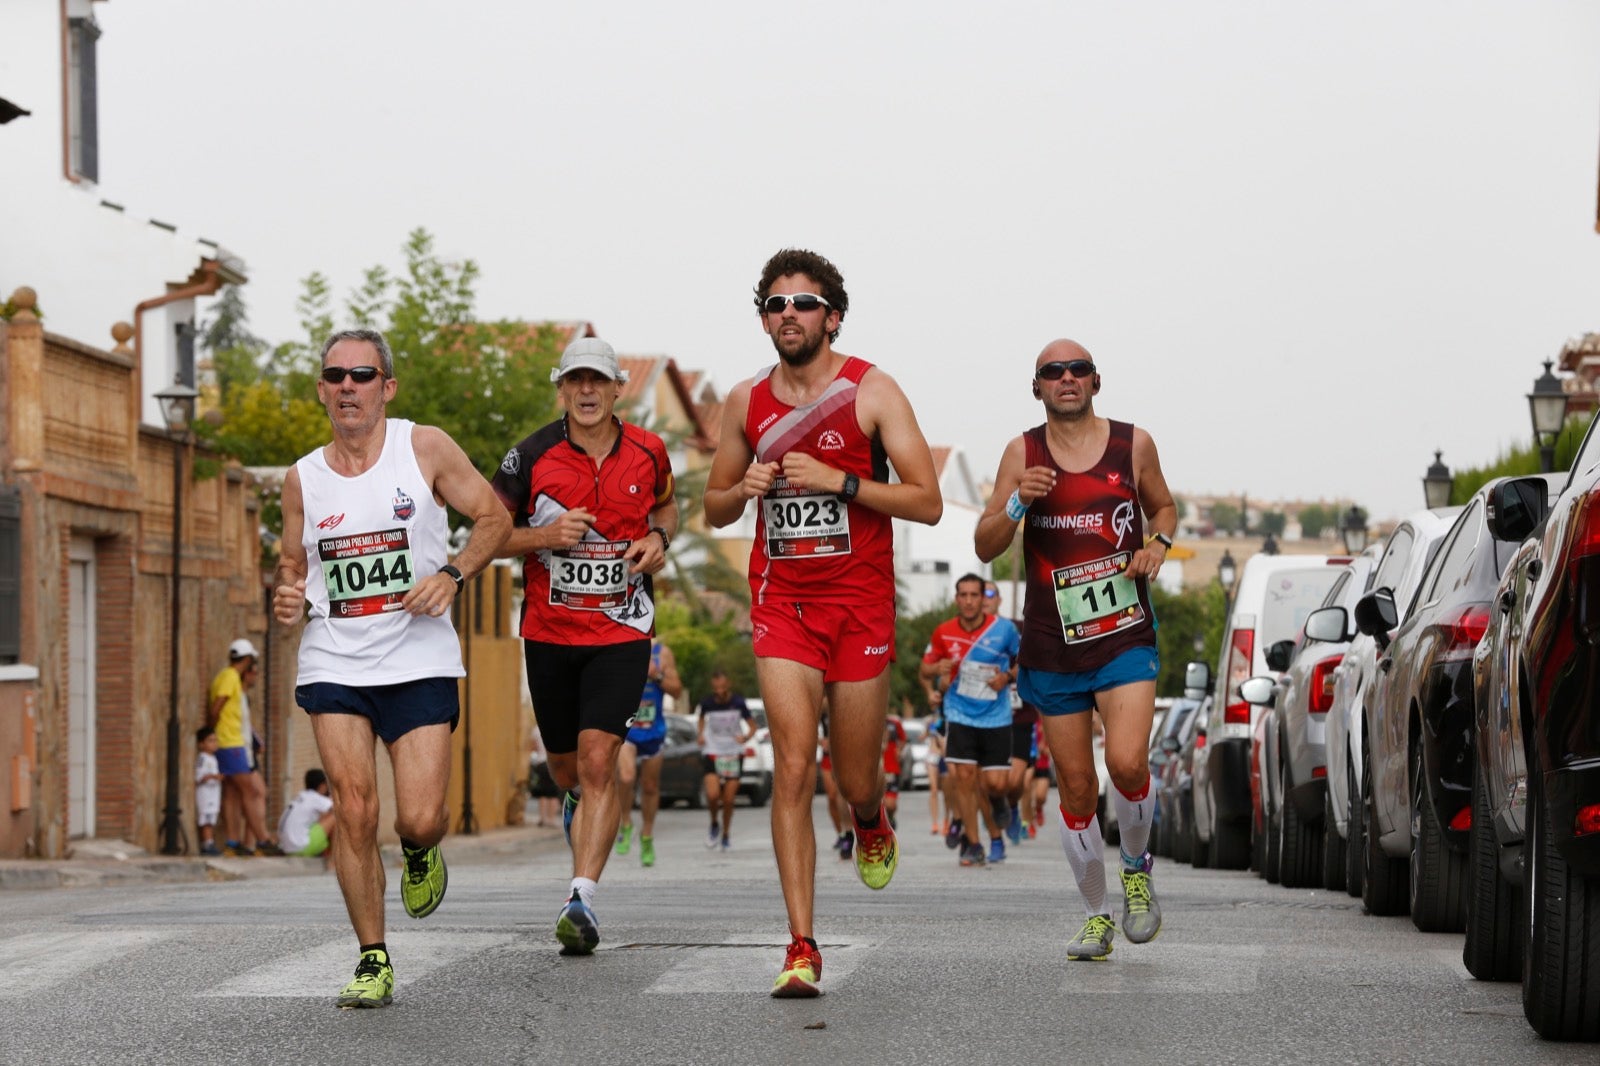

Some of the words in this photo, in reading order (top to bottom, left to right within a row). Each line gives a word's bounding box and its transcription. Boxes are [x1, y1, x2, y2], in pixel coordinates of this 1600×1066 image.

[772, 499, 840, 529] 3023
[335, 538, 351, 550] GRAN
[351, 535, 374, 548] PREMIO
[374, 534, 383, 544] DE
[382, 531, 402, 543] FONDO
[585, 542, 605, 552] PREMIO
[605, 543, 612, 552] DE
[329, 554, 412, 593] 1044
[560, 562, 624, 585] 3038
[1069, 565, 1084, 578] GRAN
[1084, 560, 1105, 575] PREMIO
[1104, 558, 1113, 568] DE
[1082, 580, 1117, 613] 11
